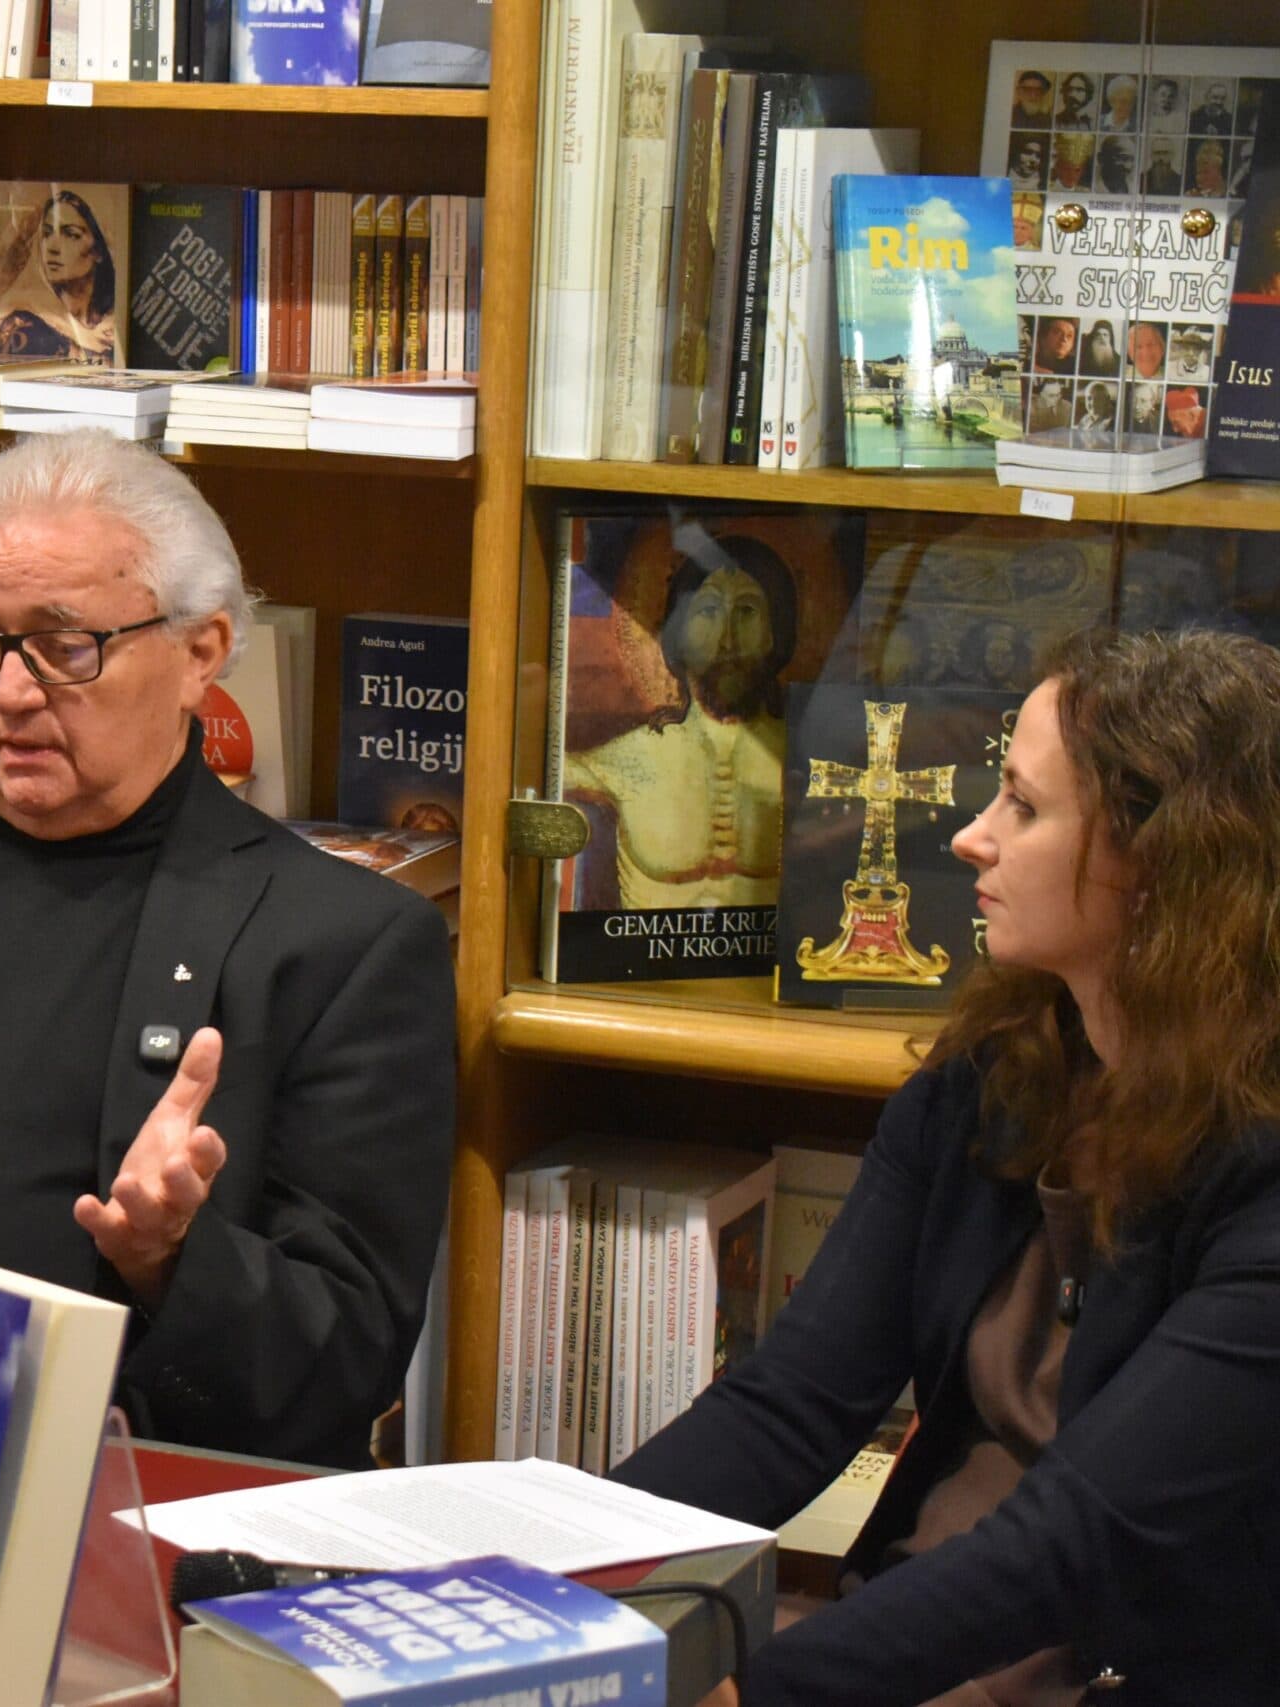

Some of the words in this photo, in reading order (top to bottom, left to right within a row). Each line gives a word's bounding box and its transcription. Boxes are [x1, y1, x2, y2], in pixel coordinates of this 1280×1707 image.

[760, 90, 772, 146] KAŠTELIMA
[754, 159, 766, 213] STOMORIJE
[751, 214, 761, 245] GOSPE
[867, 222, 969, 270] Rim
[745, 296, 754, 315] VRT
[1226, 360, 1274, 386] Isus
[359, 635, 397, 650] Andrea
[398, 638, 426, 653] Aguti
[603, 912, 716, 937] GEMALTE
[647, 938, 675, 959] IN
[573, 1243, 582, 1282] STAROGA
[596, 1246, 605, 1285] STAROGA
[668, 1230, 679, 1285] OTAJSTVA
[688, 1235, 700, 1290] OTAJSTVA
[546, 1336, 556, 1366] KRIST
[552, 1210, 562, 1259] VREMENA
[571, 1286, 579, 1308] TEME
[595, 1289, 603, 1311] TEME
[667, 1287, 678, 1341] KRISTOVA
[687, 1292, 697, 1346] KRISTOVA
[565, 1386, 574, 1430] ADALBERT
[589, 1390, 599, 1433] ADALBERT
[296, 1586, 455, 1662] DIKA
[343, 1578, 507, 1652] NEBE
[426, 1577, 559, 1642] SKA
[279, 1606, 390, 1671] TRSTENJAK
